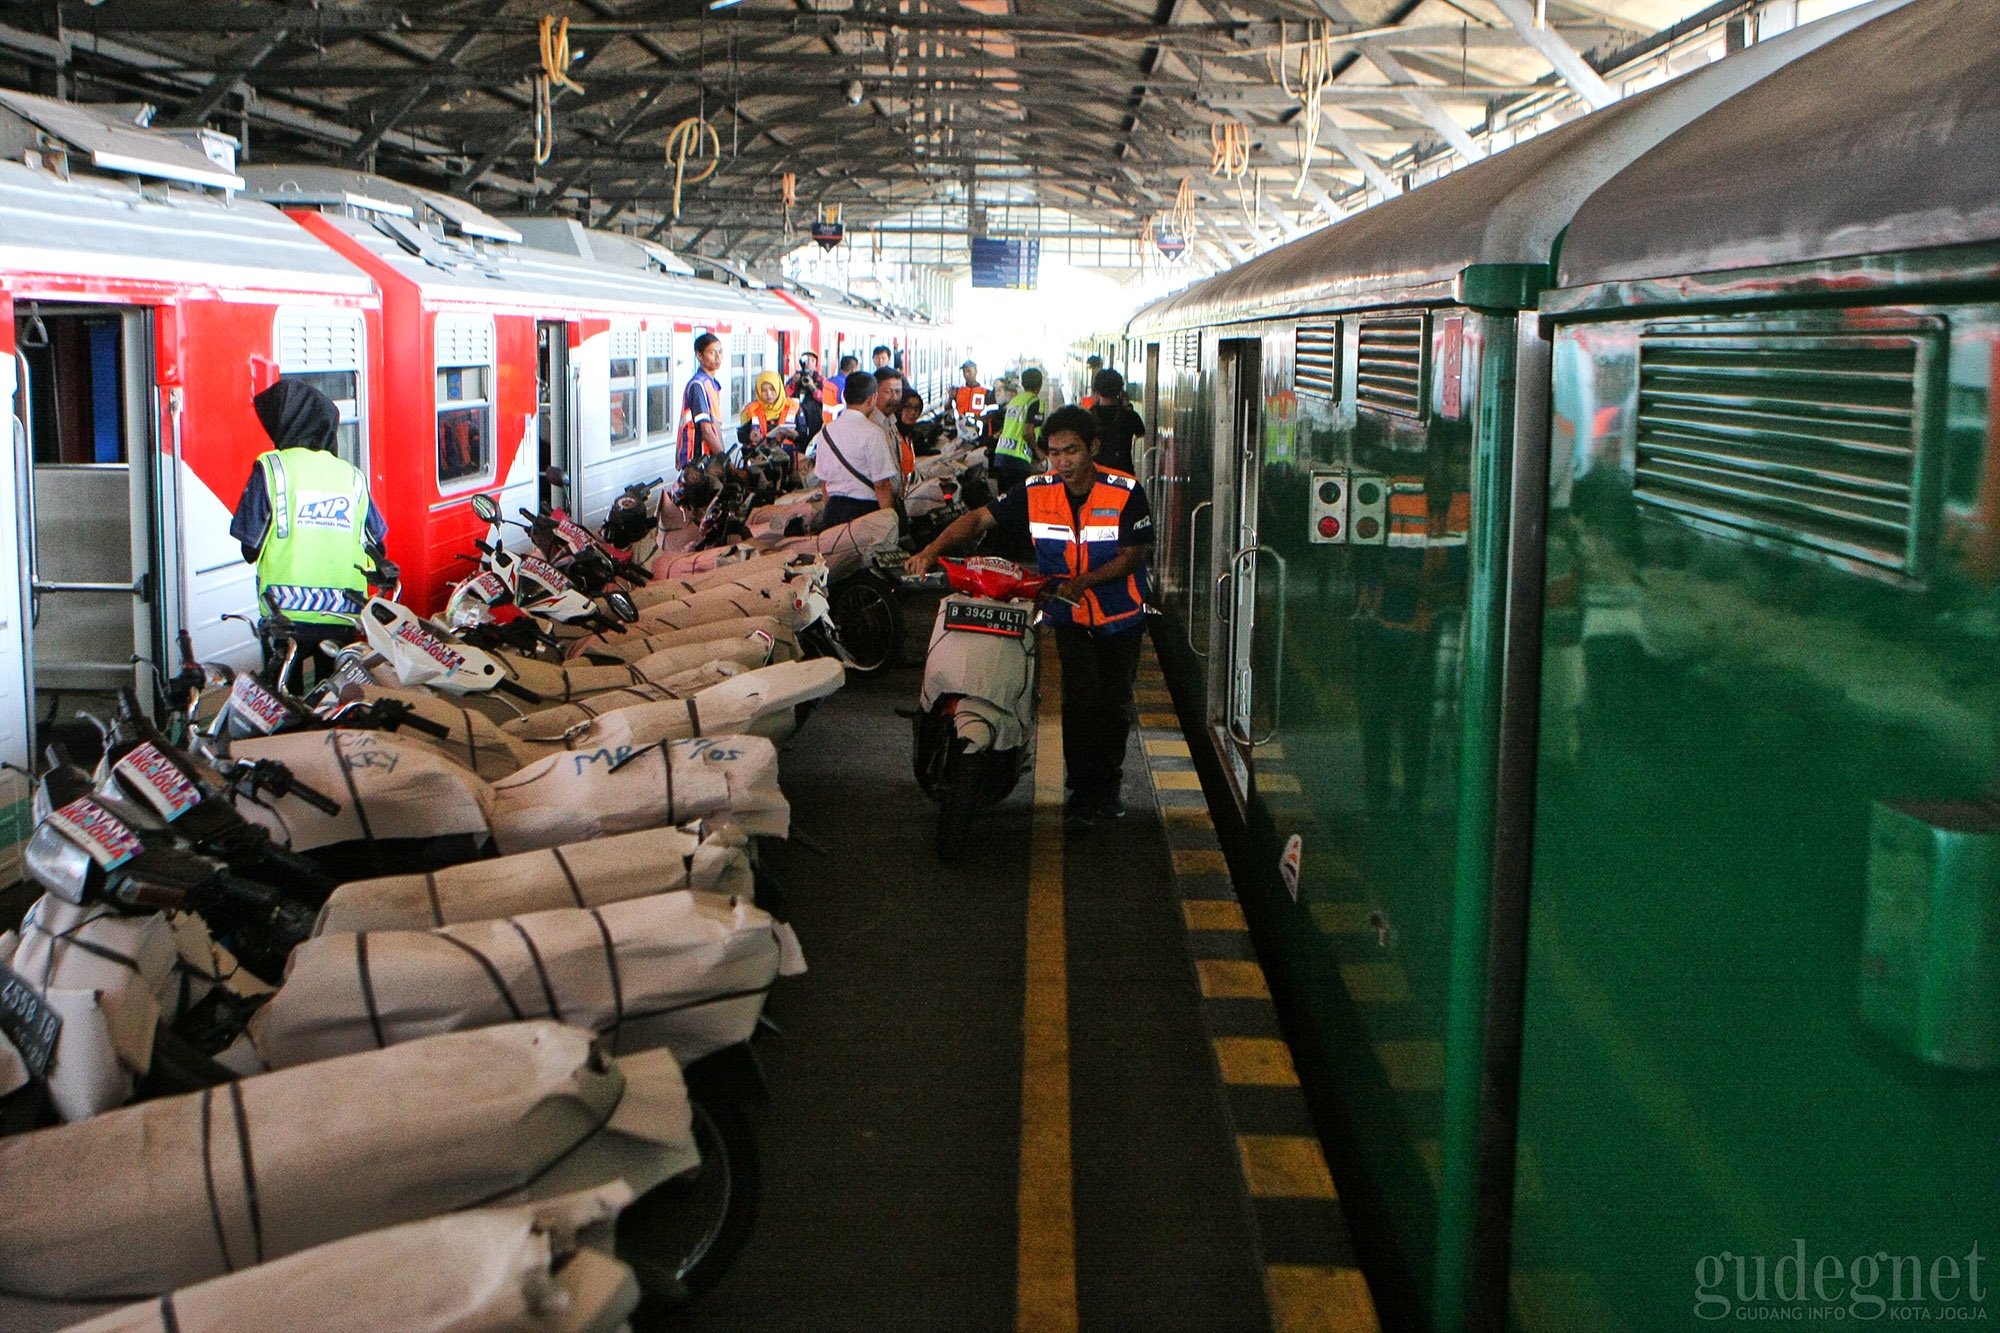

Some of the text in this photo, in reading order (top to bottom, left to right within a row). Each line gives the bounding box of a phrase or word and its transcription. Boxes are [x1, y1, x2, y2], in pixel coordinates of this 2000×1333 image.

[526, 556, 562, 579] SELATAN
[951, 607, 1020, 624] B 3945 ULT
[397, 628, 457, 670] JAKG-JOGJA
[404, 621, 456, 657] SELATAN
